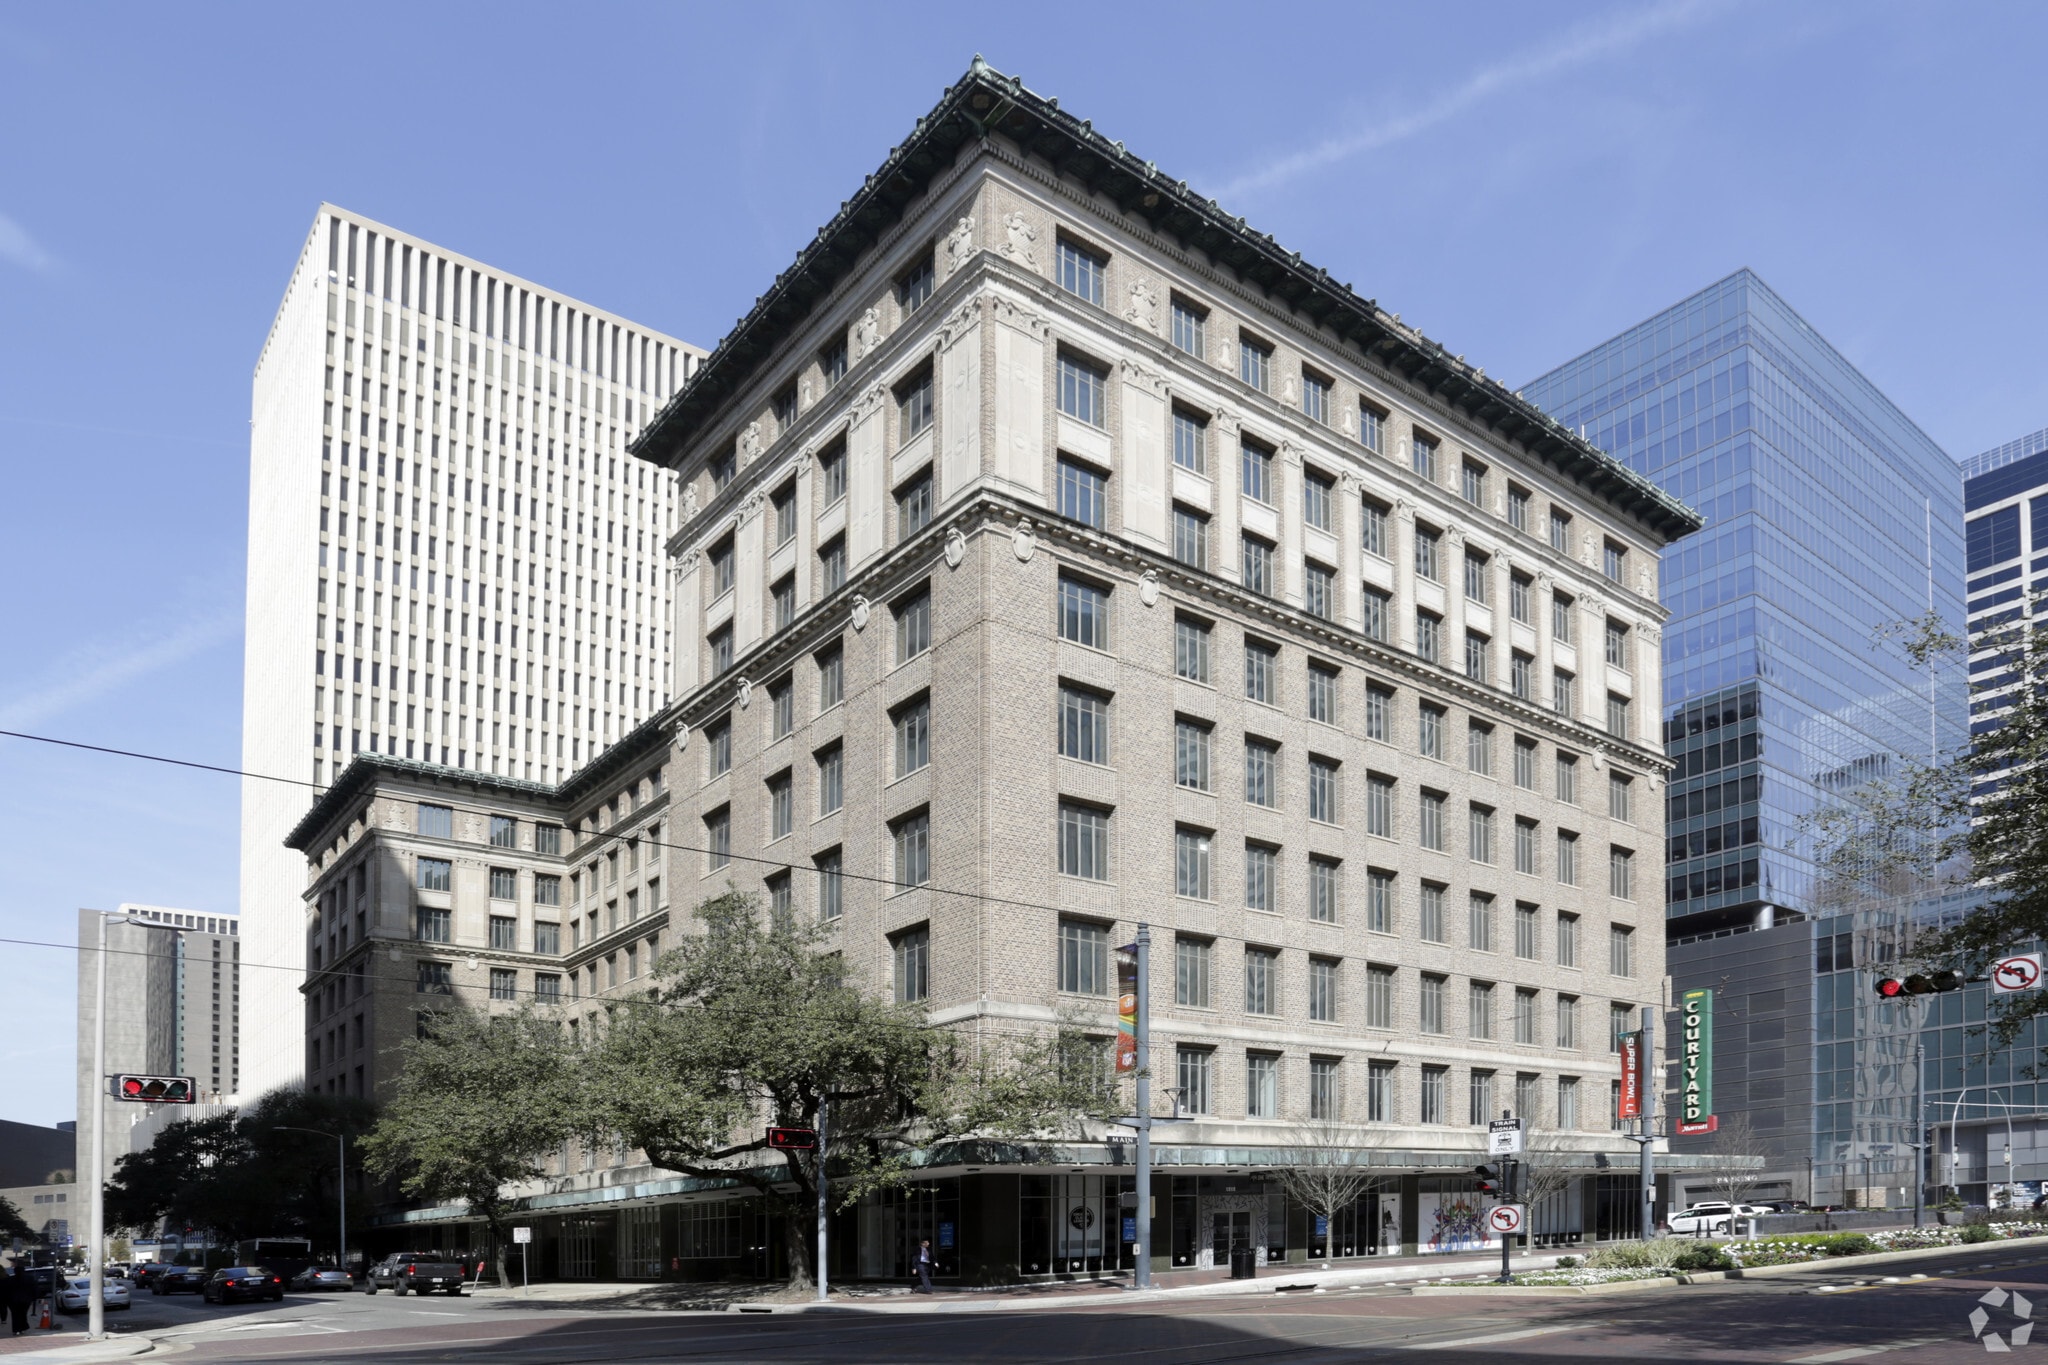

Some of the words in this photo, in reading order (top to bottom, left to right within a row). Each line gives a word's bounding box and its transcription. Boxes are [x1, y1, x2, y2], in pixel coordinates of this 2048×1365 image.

[1626, 1037, 1635, 1070] SUPER
[1686, 1001, 1701, 1119] COURTYARD
[1626, 1073, 1635, 1101] BOWL
[1625, 1103, 1634, 1113] LI
[1112, 1136, 1133, 1144] MAIN
